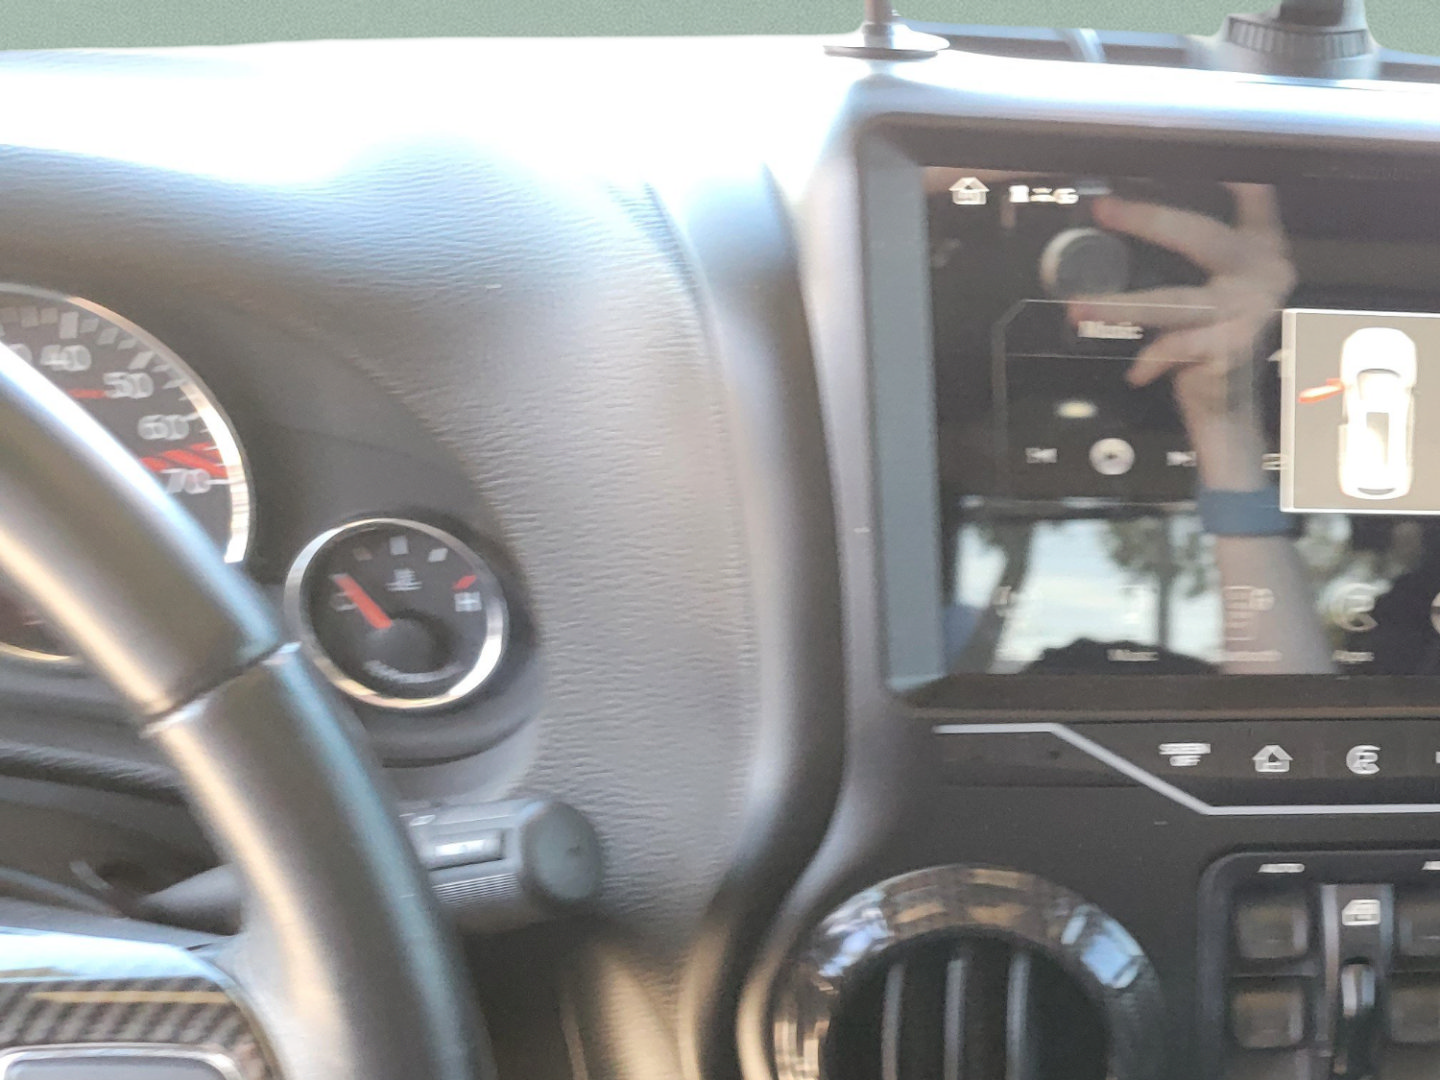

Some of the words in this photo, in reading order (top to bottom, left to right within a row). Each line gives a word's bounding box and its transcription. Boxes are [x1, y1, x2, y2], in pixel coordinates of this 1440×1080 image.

[40, 344, 92, 371] 40
[103, 371, 154, 399] 50
[137, 414, 190, 440] 60
[160, 467, 211, 495] 70
